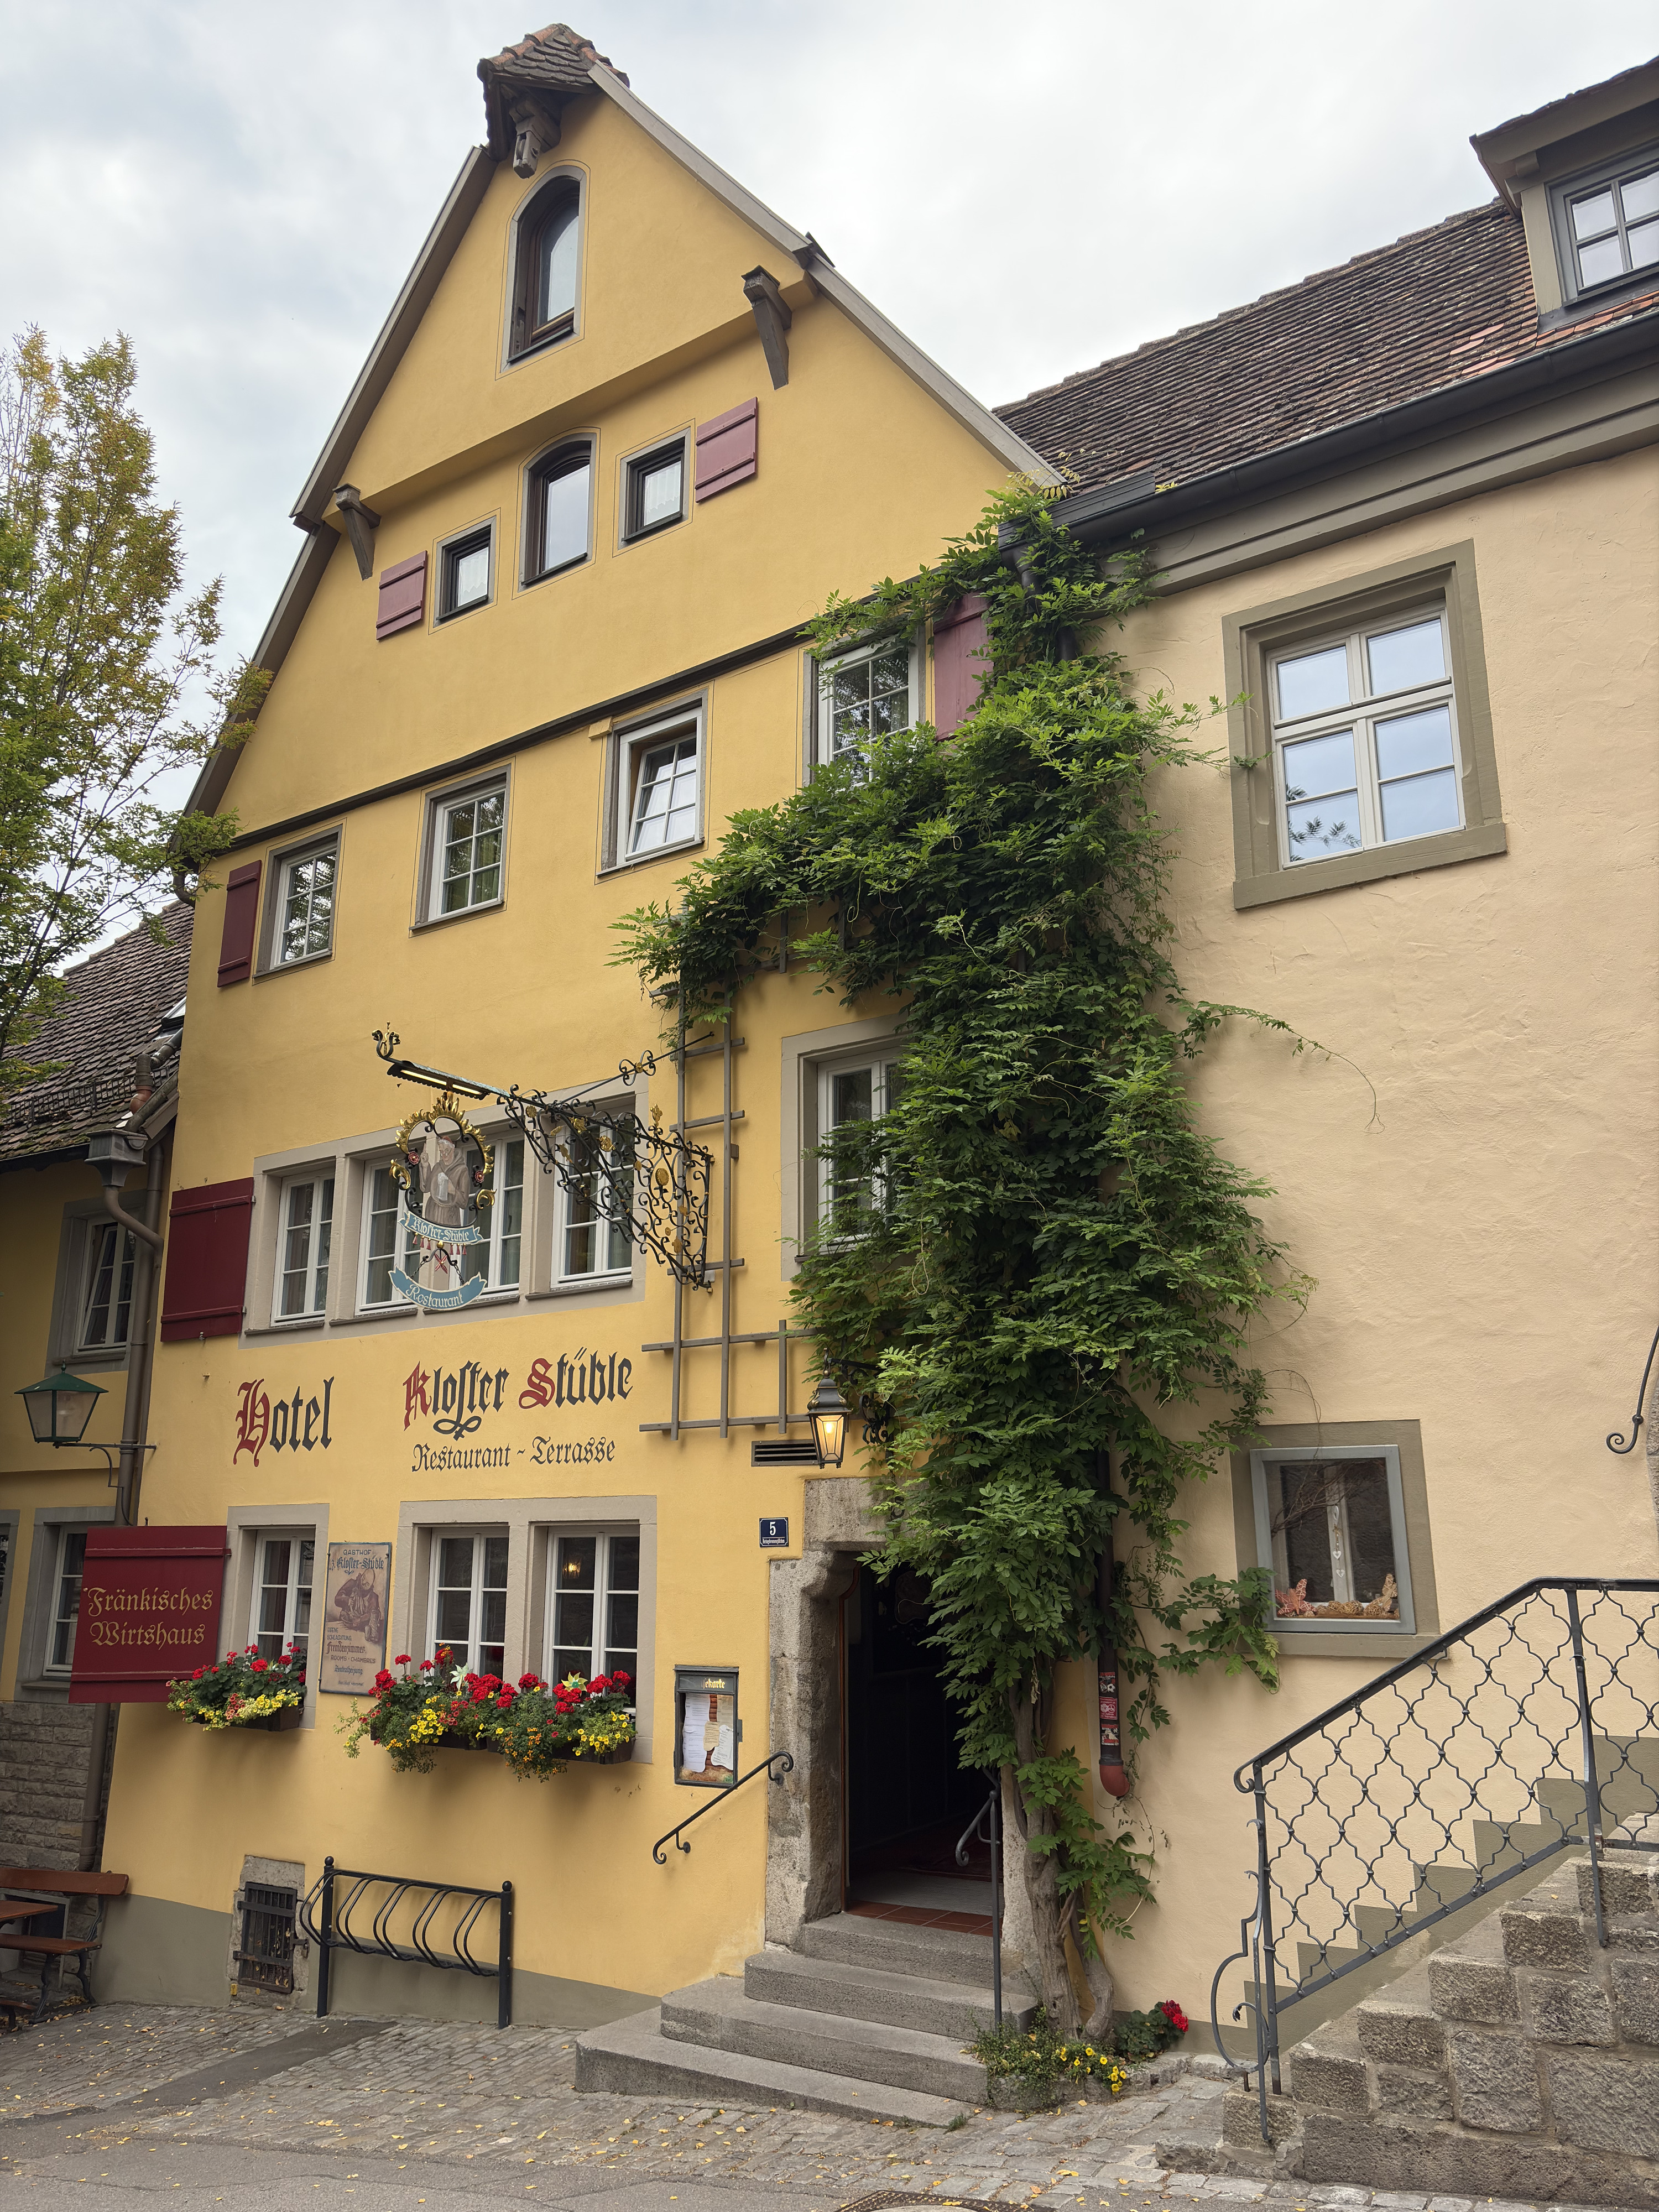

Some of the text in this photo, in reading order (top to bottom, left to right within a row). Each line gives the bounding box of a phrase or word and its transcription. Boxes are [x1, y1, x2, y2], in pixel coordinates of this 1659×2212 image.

[406, 1284, 463, 1308] Restaurant
[518, 1347, 633, 1409] Stüble
[233, 1376, 334, 1467] Hotel
[412, 1443, 511, 1472] Restaurant
[530, 1436, 615, 1465] Terrasse
[769, 1521, 776, 1536] 5
[88, 1587, 213, 1616] Fränkisches
[90, 1621, 205, 1650] Wirtshaus
